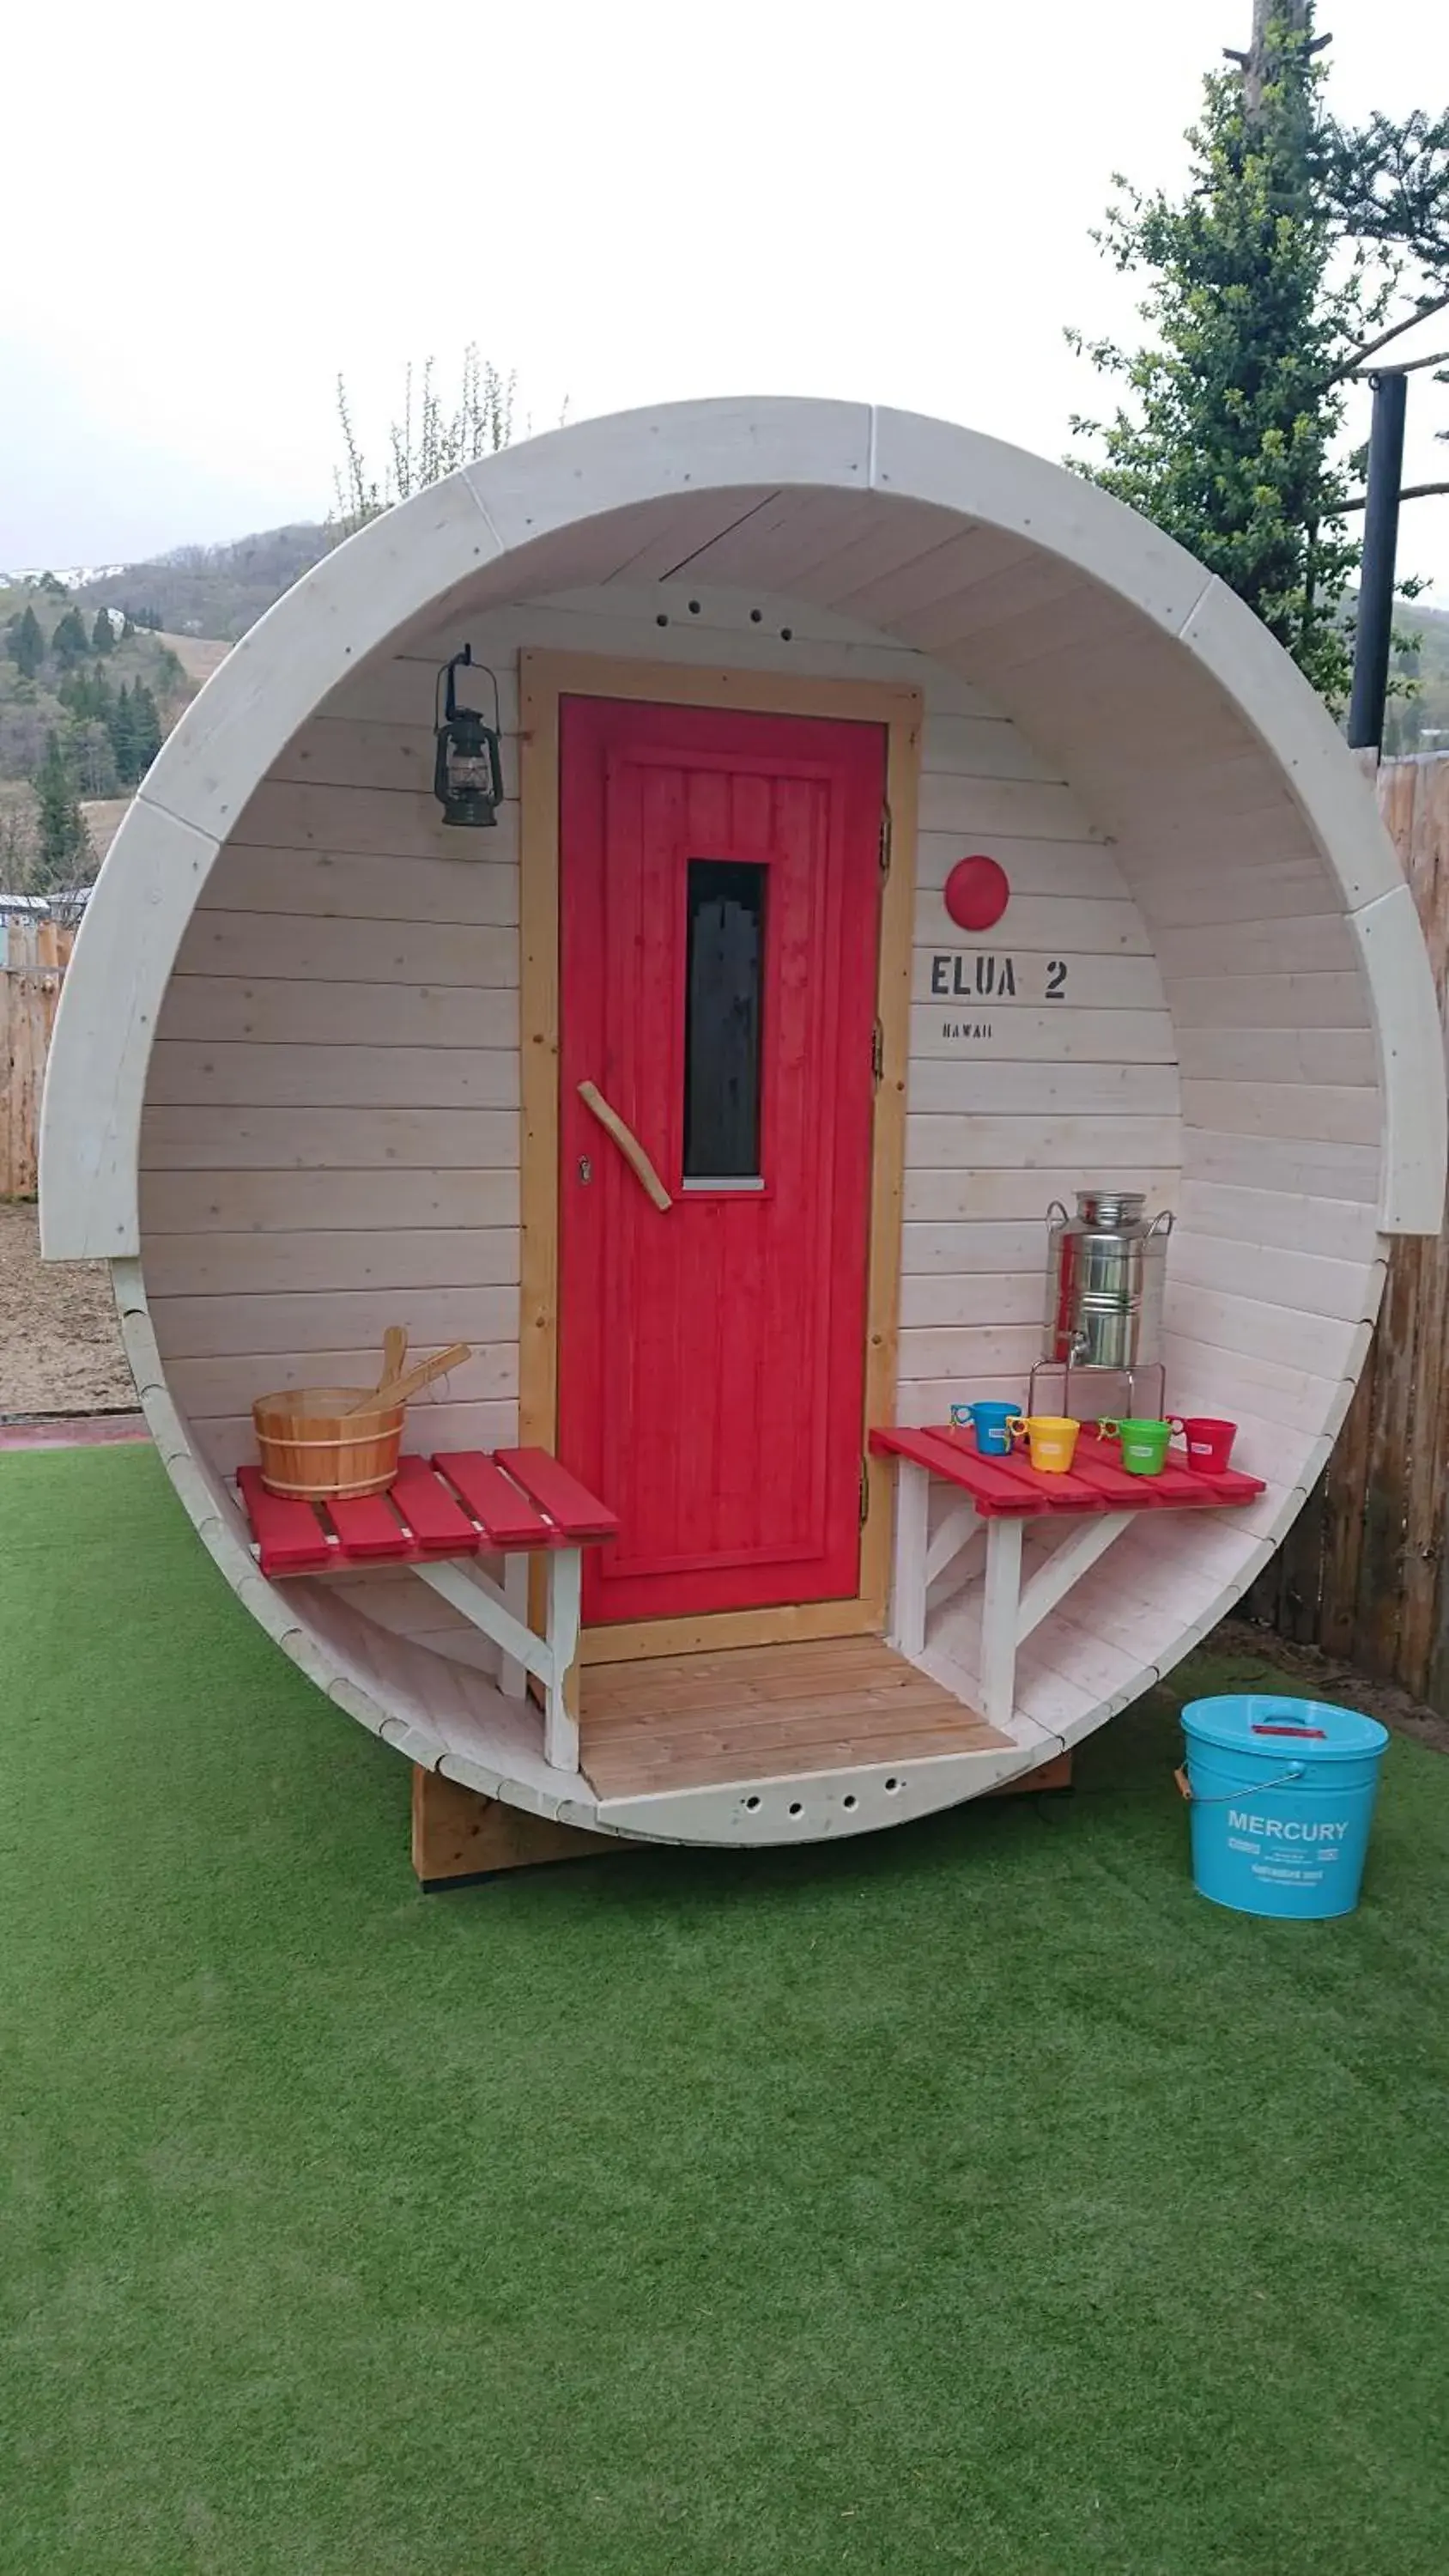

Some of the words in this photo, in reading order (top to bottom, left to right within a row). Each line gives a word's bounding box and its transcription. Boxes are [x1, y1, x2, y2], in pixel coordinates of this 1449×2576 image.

[932, 956, 1016, 995] ELUA
[1045, 961, 1068, 999] 2
[943, 1022, 992, 1039] HAWAII
[1228, 1809, 1349, 1842] MERCURY
